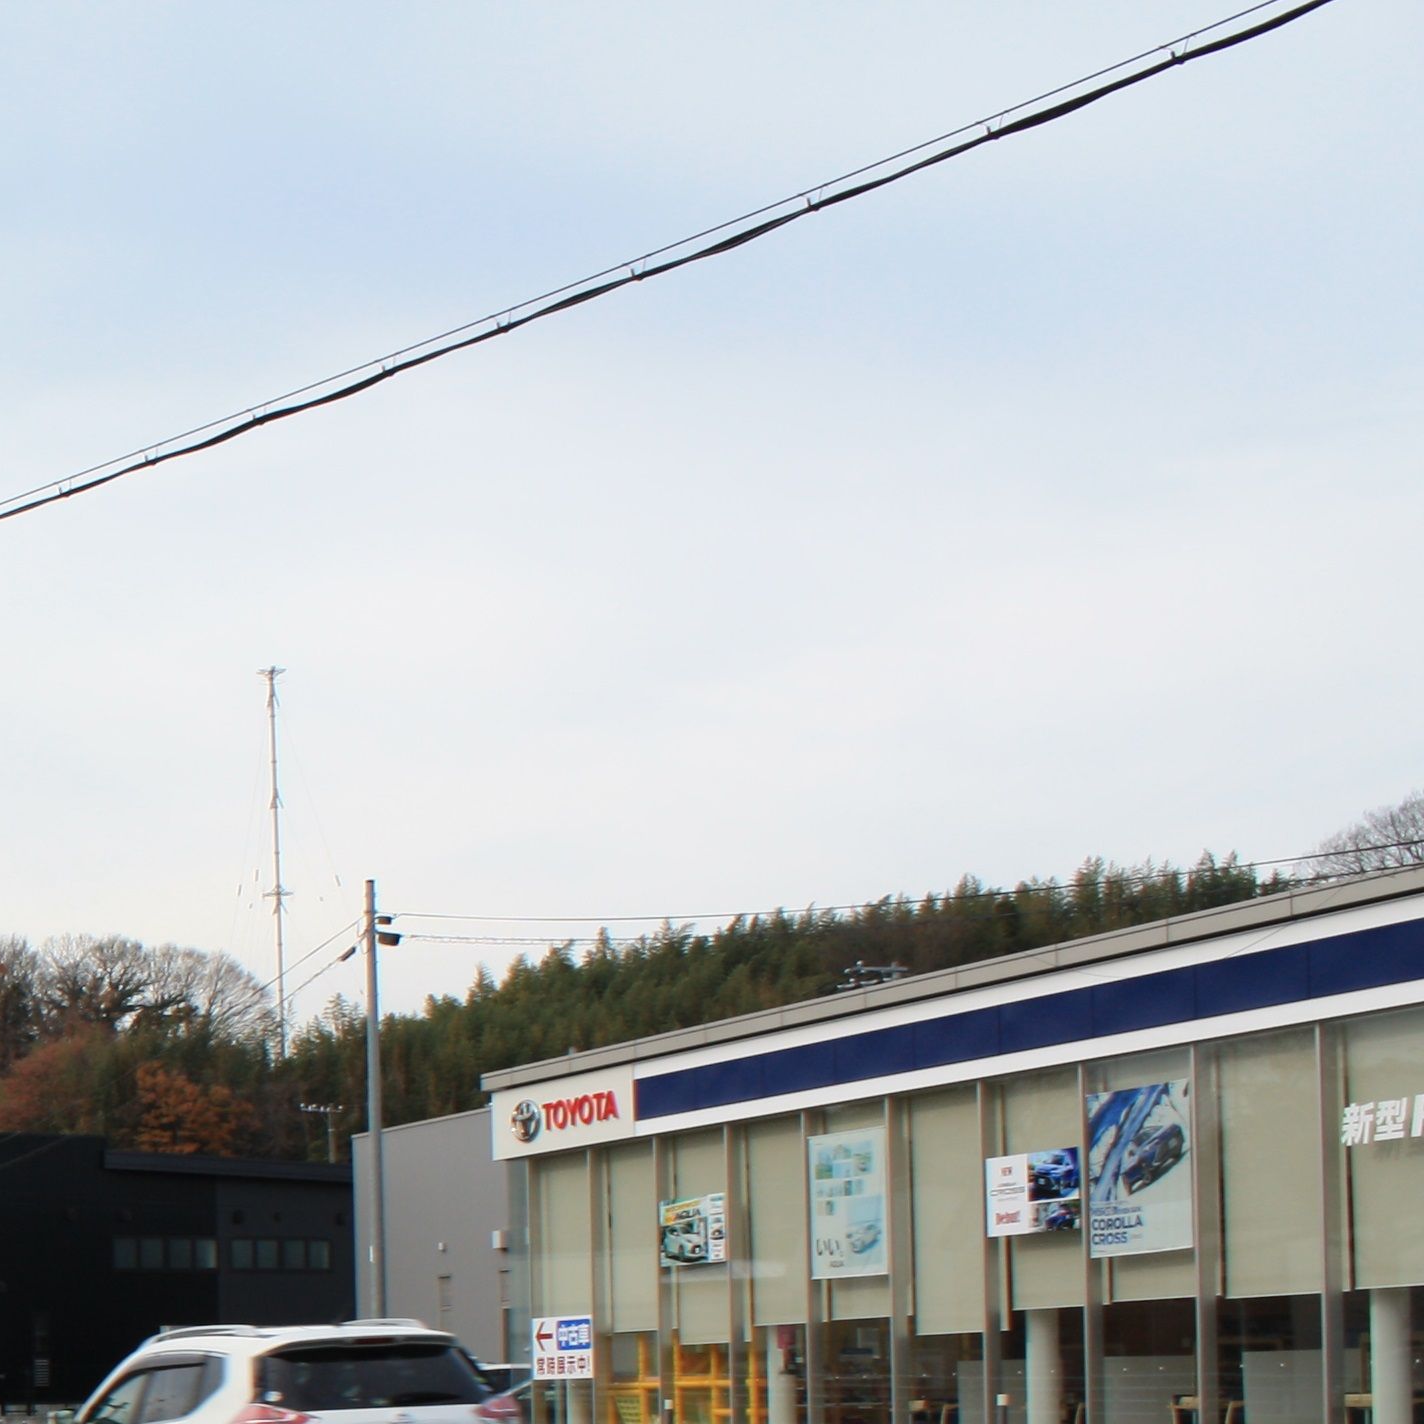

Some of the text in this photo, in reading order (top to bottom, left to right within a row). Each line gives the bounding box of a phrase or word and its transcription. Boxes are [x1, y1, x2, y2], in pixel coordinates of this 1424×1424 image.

[543, 1090, 619, 1131] TOYOTA
[1092, 1216, 1143, 1231] COROLLA
[1092, 1231, 1128, 1245] CROSS
[559, 1324, 590, 1346] 中古車
